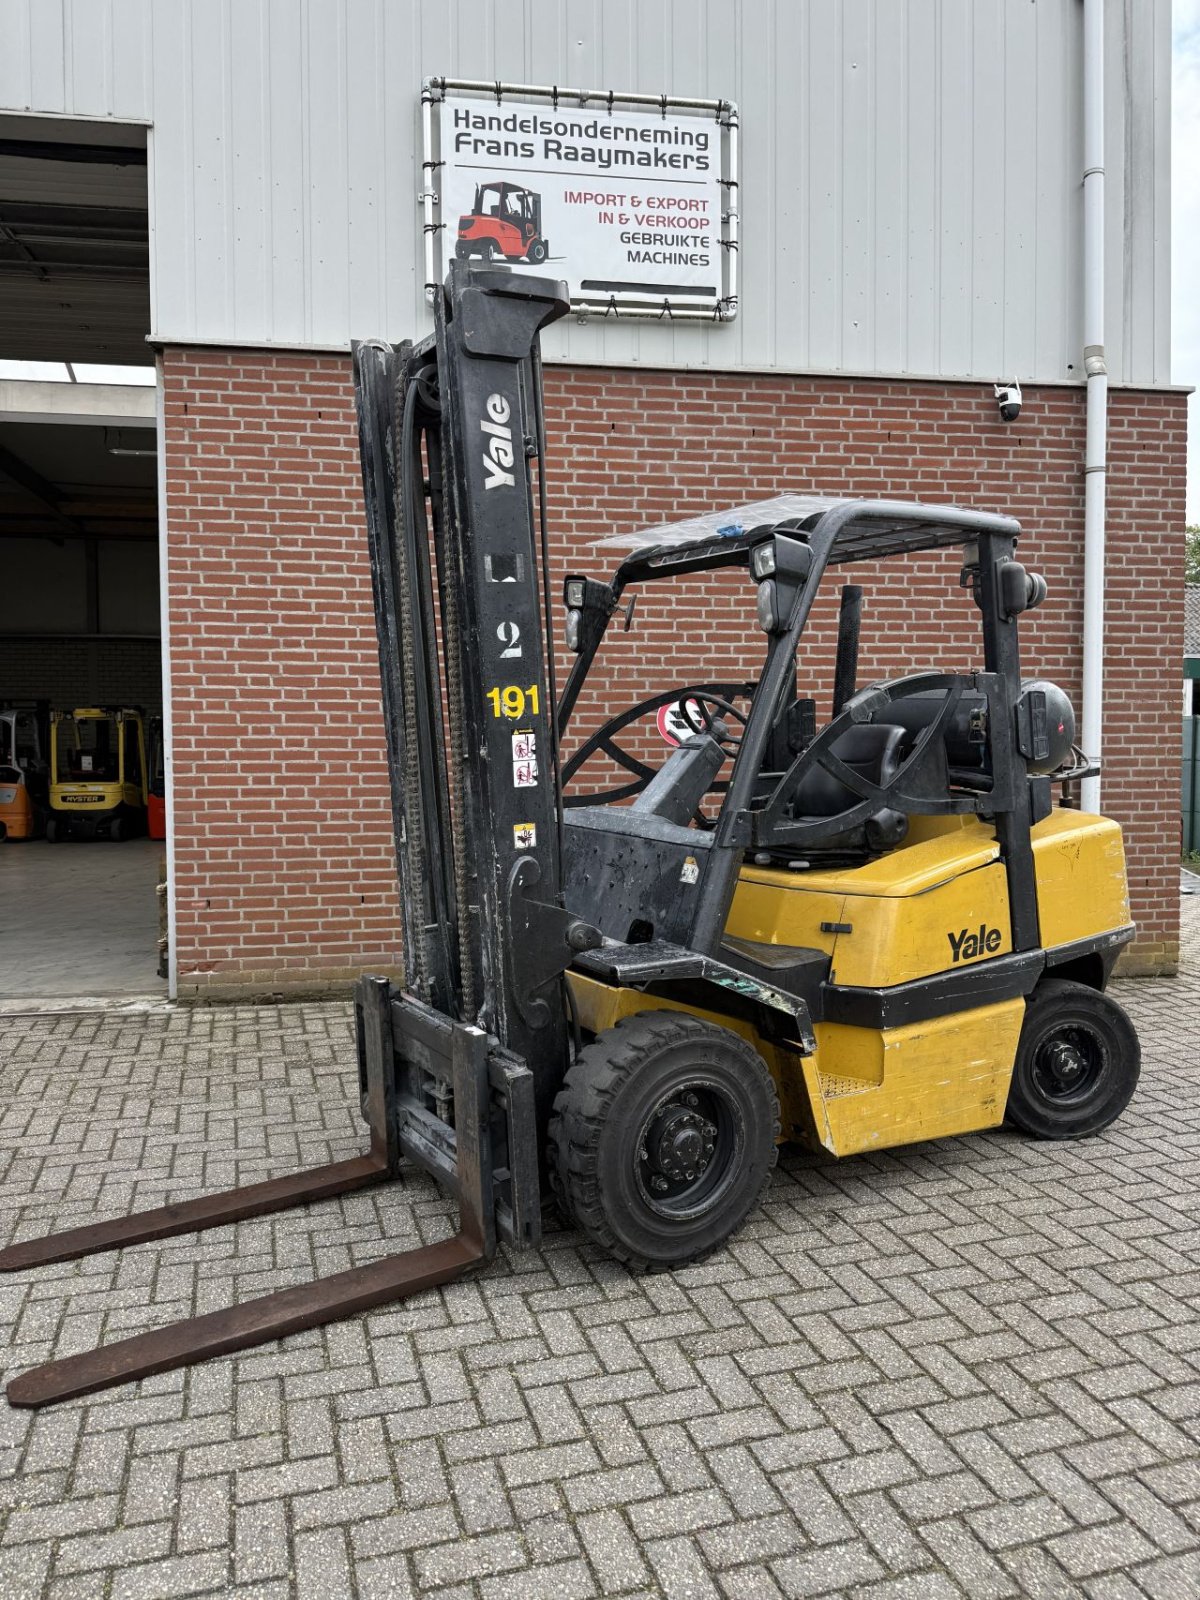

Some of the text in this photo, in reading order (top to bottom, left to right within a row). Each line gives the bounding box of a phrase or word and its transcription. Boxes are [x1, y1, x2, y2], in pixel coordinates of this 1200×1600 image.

[454, 109, 709, 151] Handelsonderneming
[455, 132, 710, 170] Frans Raaymakers
[564, 190, 709, 212] IMPORT & EXPORT
[598, 211, 710, 230] IN & VERKOOP
[620, 231, 710, 248] GEBRUIKTE
[627, 250, 710, 266] MACHINES
[480, 393, 516, 490] Yale
[496, 621, 523, 659] 2
[486, 684, 540, 720] 191
[947, 924, 1002, 962] Yale
